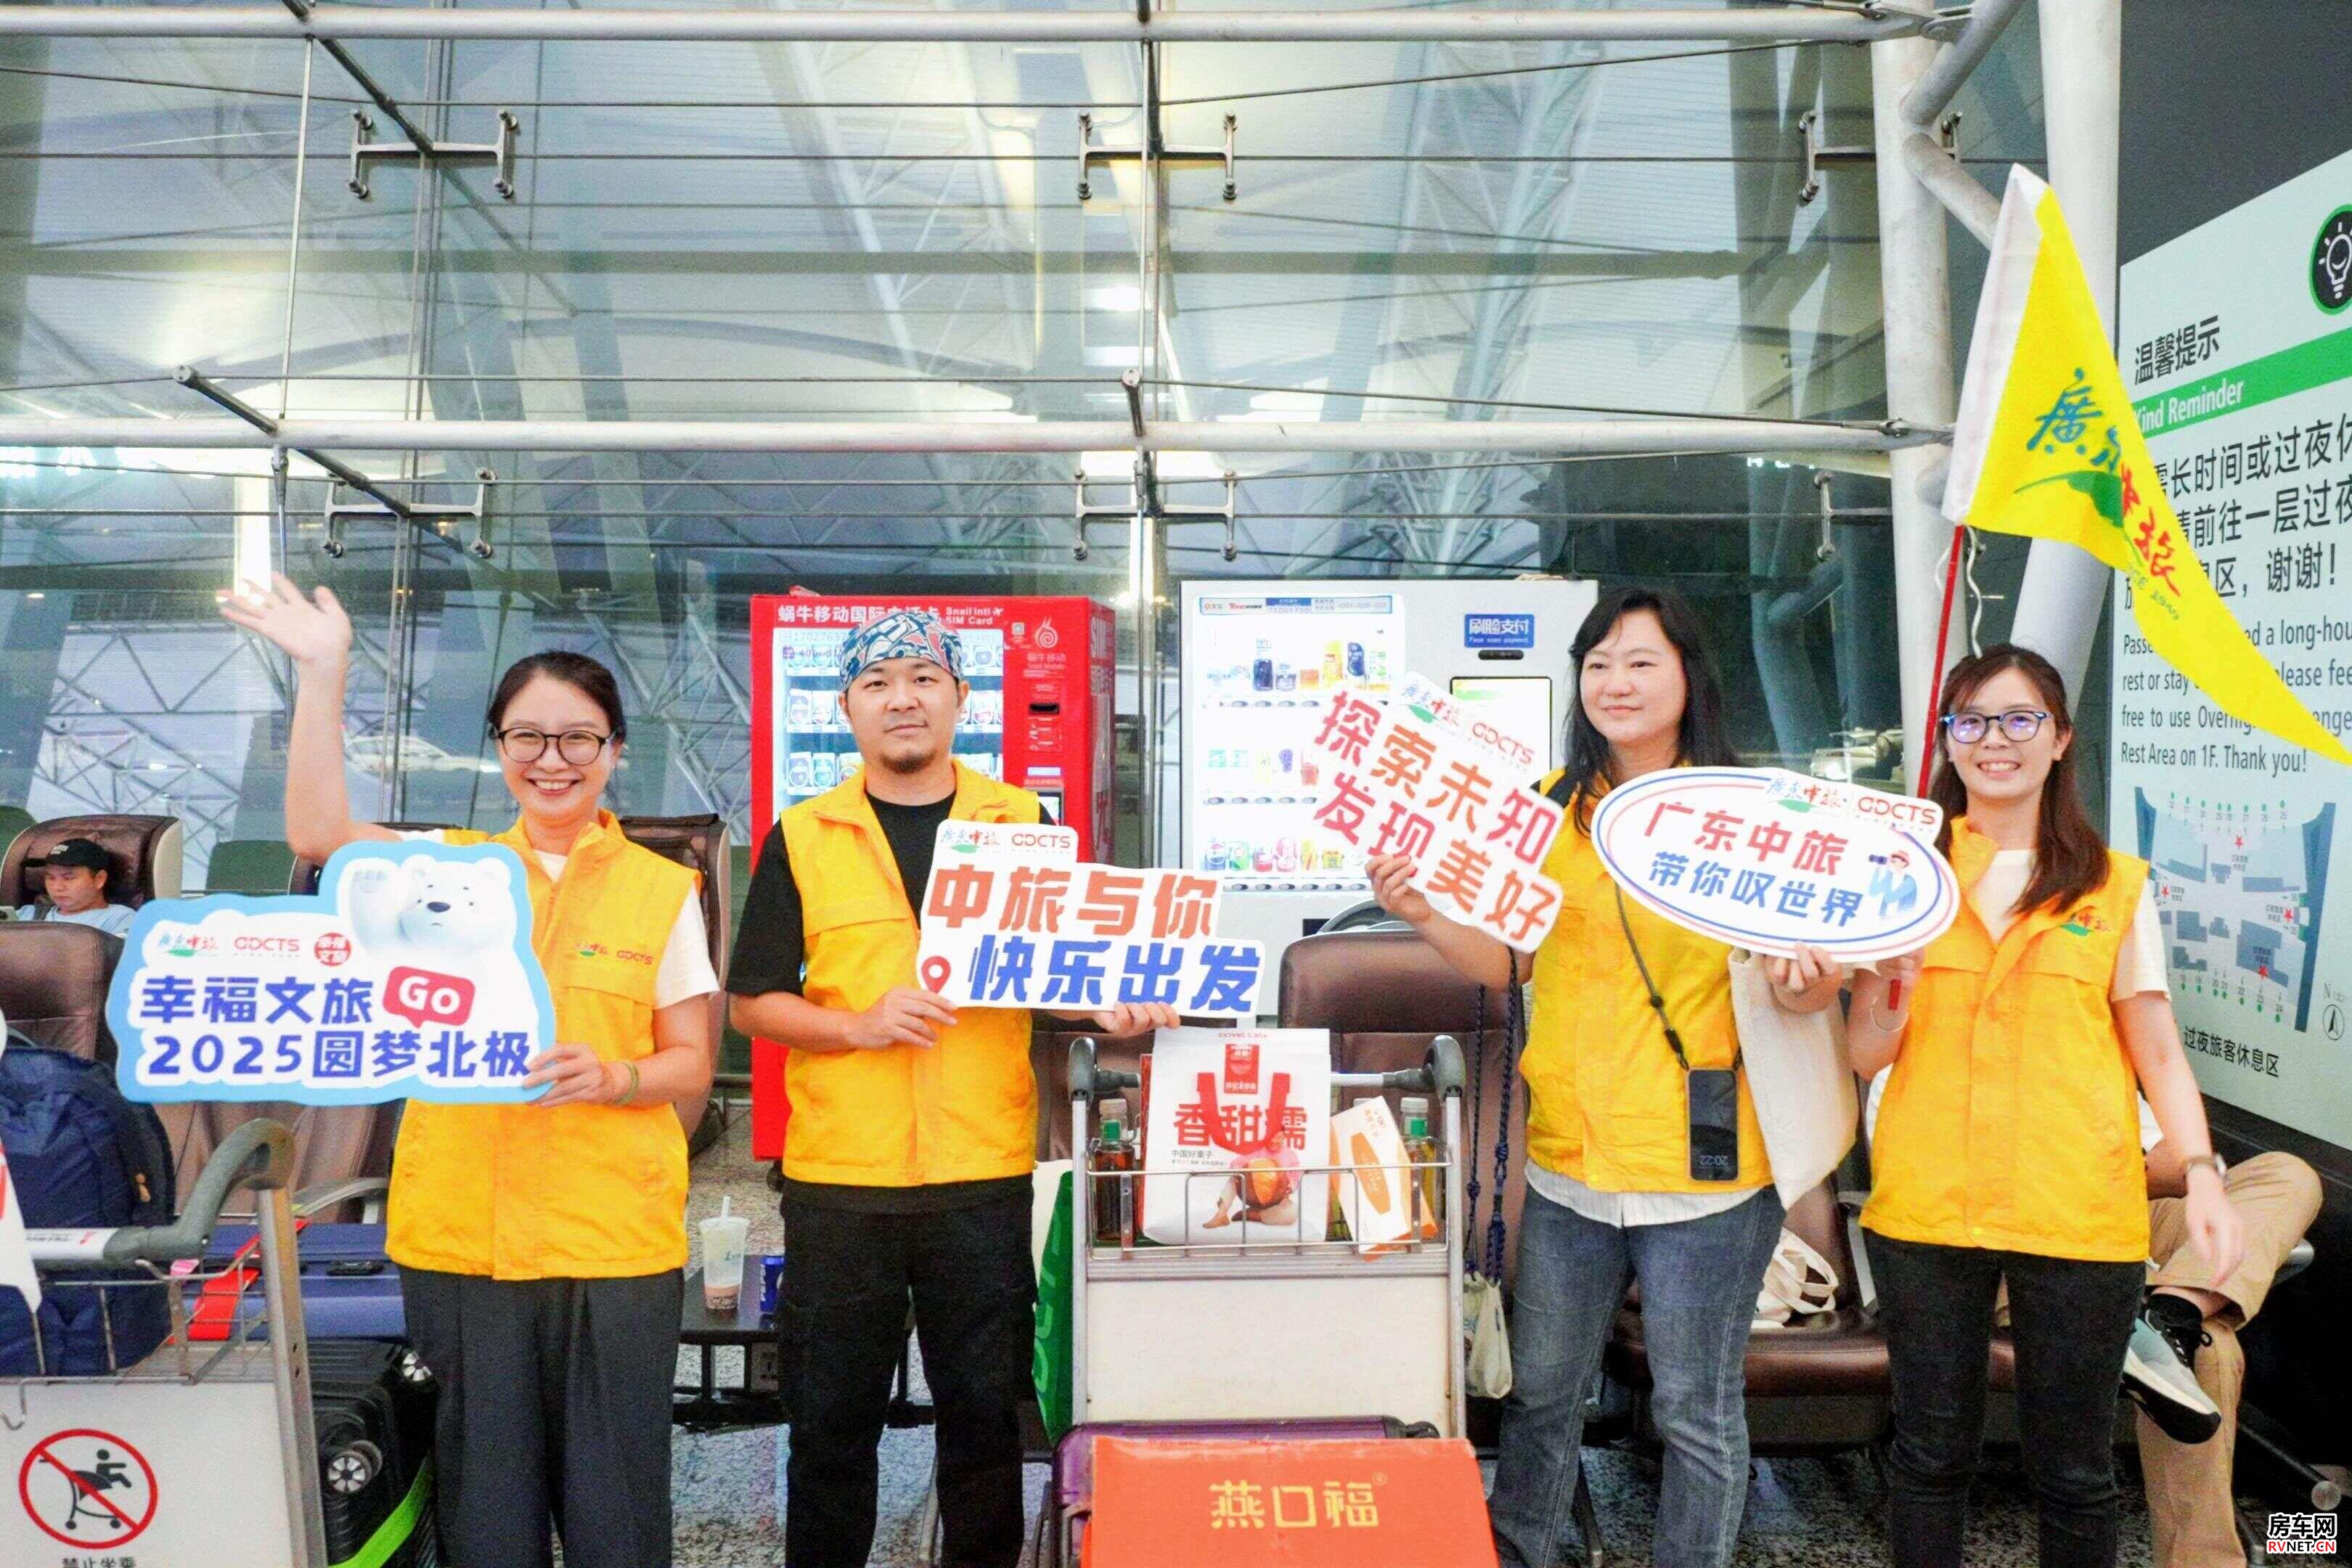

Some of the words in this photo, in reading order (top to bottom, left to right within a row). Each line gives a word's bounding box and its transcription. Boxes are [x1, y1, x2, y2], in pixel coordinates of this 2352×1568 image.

[2134, 314, 2220, 385] 温馨提示
[2168, 377, 2245, 425] Reminder
[968, 617, 993, 626] Card
[1469, 618, 1530, 635] 刷脸支付
[2266, 627, 2274, 646] a
[2123, 671, 2144, 690] rest
[2148, 674, 2160, 690] or
[2164, 669, 2189, 696] stay
[2275, 661, 2322, 687] lease
[2121, 704, 2144, 727] free
[2151, 706, 2163, 727] to
[2170, 710, 2191, 727] use
[1313, 690, 1558, 865] 探索未知
[2121, 742, 2146, 764] Rest
[2147, 742, 2176, 766] Area
[2180, 748, 2196, 767] on
[2202, 744, 2218, 768] 1F.
[2224, 743, 2267, 771] Thank
[2272, 748, 2307, 778] you!
[1313, 772, 1557, 942] 发现美好
[1643, 800, 1850, 876] 广东中旅
[927, 862, 1219, 940] 中旅与你
[1648, 850, 1864, 927] 带你叹世界
[968, 934, 1260, 1013] 快乐出发
[140, 976, 373, 1025] 幸福文旅
[148, 1029, 531, 1079] 2025圆梦北极
[2184, 1025, 2280, 1077] 过夜旅客休息区
[1209, 1479, 1379, 1528] 燕口福
